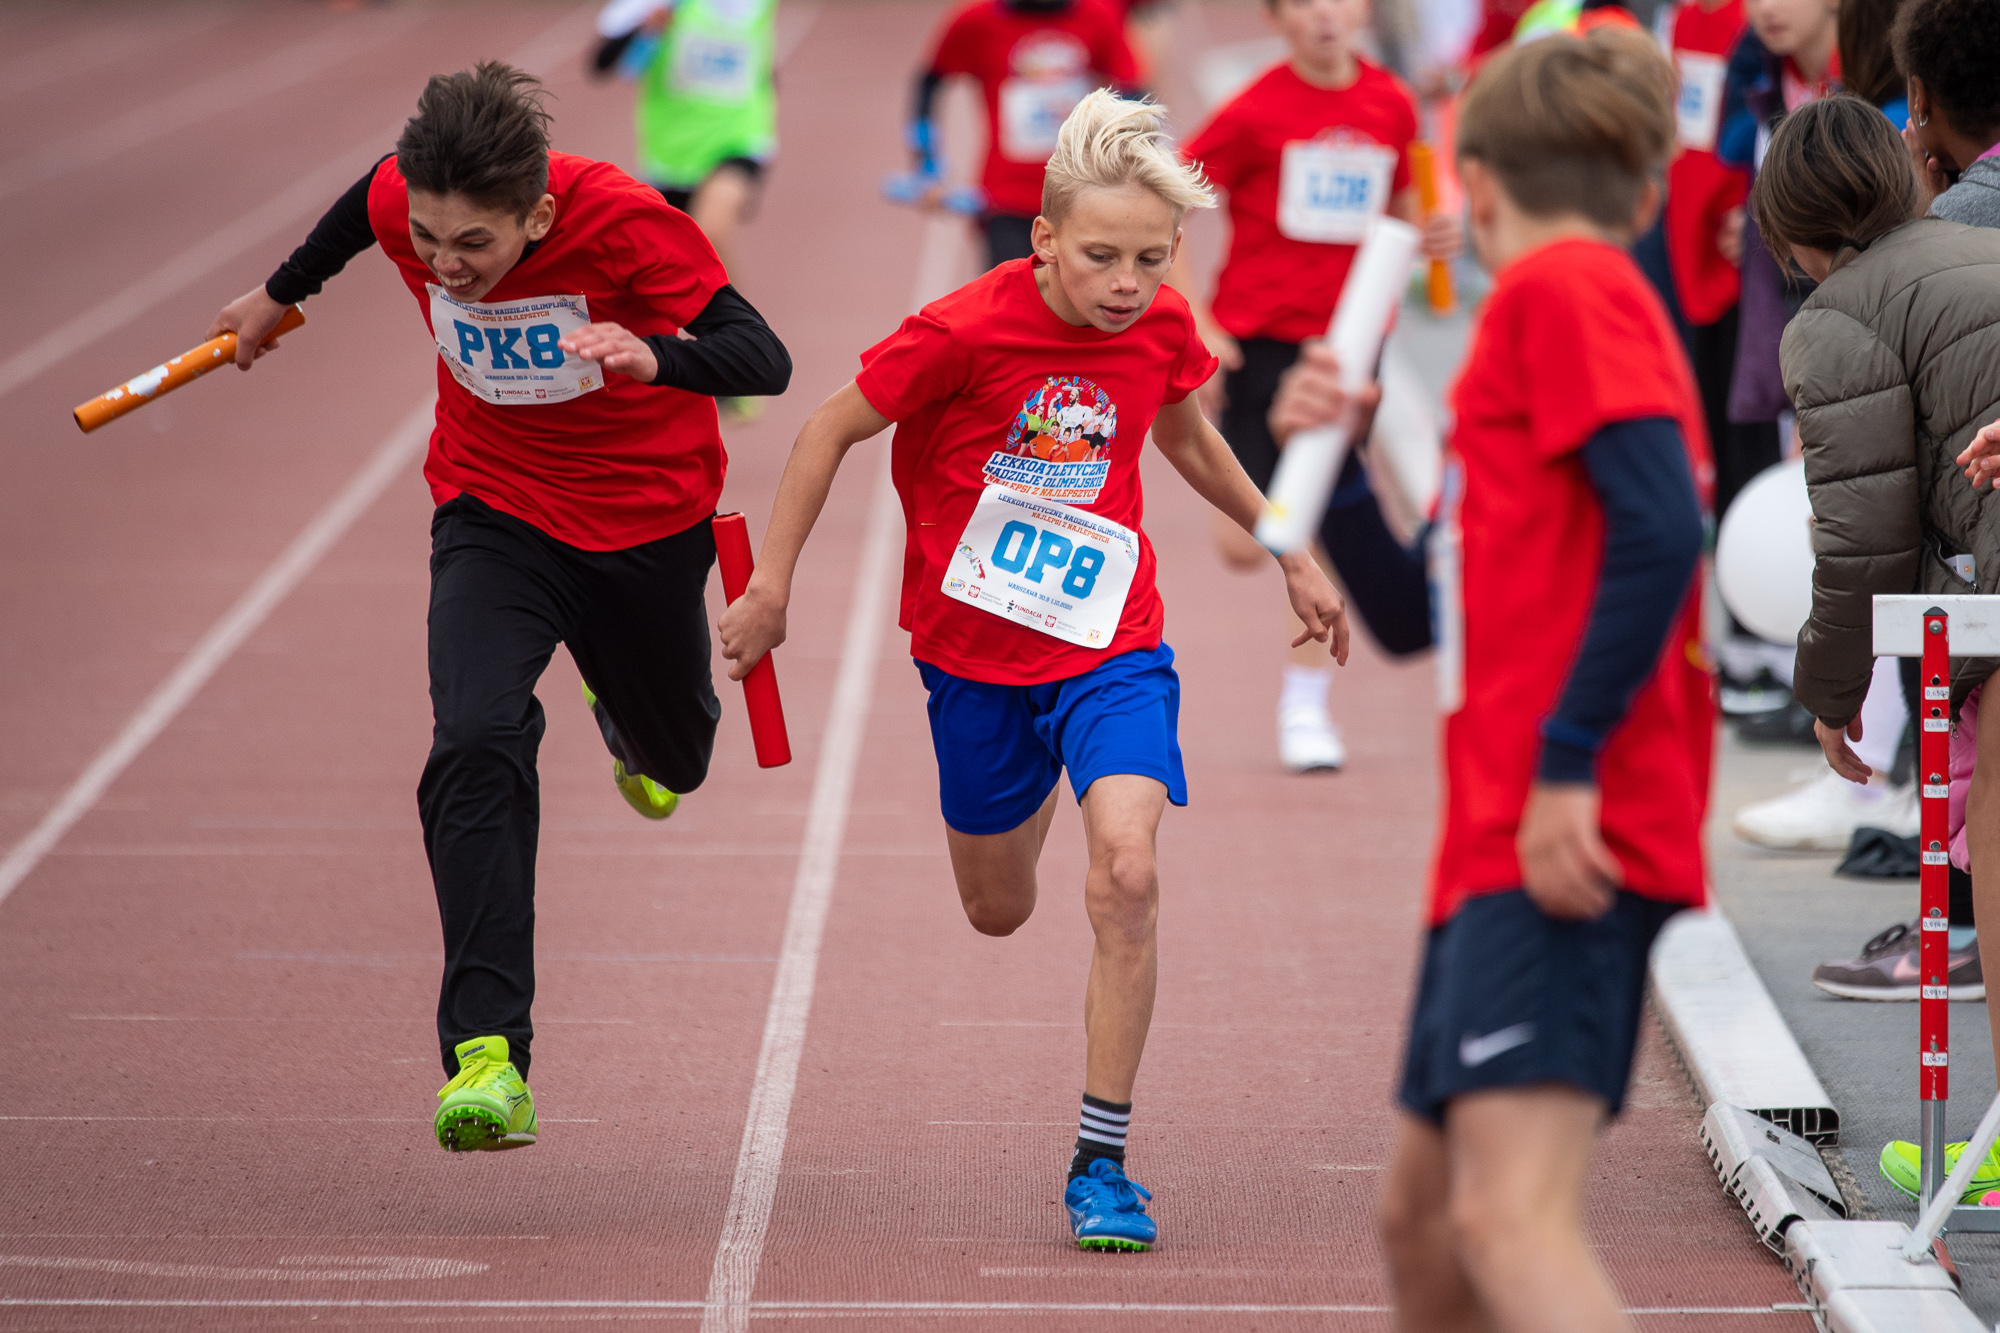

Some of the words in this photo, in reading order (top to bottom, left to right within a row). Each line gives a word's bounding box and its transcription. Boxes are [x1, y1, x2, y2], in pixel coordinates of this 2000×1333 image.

[468, 312, 496, 322] NAJLEPSI
[503, 310, 550, 322] NAJLEPSZYCH
[494, 305, 530, 316] NADZIEJE
[531, 301, 576, 312] OLIMPIJSKIE
[453, 318, 565, 370] PK8
[990, 453, 1109, 476] LEKKOATLETYCZNE
[984, 465, 1043, 486] NADZIEJE
[1042, 476, 1104, 488] OLIMPIJSKIE
[1031, 487, 1040, 495] Z
[1039, 488, 1098, 498] NAJLEPSZYCH
[998, 493, 1063, 519] LEKKOATLETYCZNE
[1064, 513, 1097, 531] NADZIEJE
[1097, 525, 1132, 544] OLIMPIJSKIE
[1031, 512, 1062, 527] NAJLEPSI
[1067, 522, 1110, 544] NAJLEPSZYCH
[990, 519, 1106, 600] OP8
[1008, 581, 1038, 598] WARSZAWA
[1014, 604, 1042, 619] FUNDACJA
